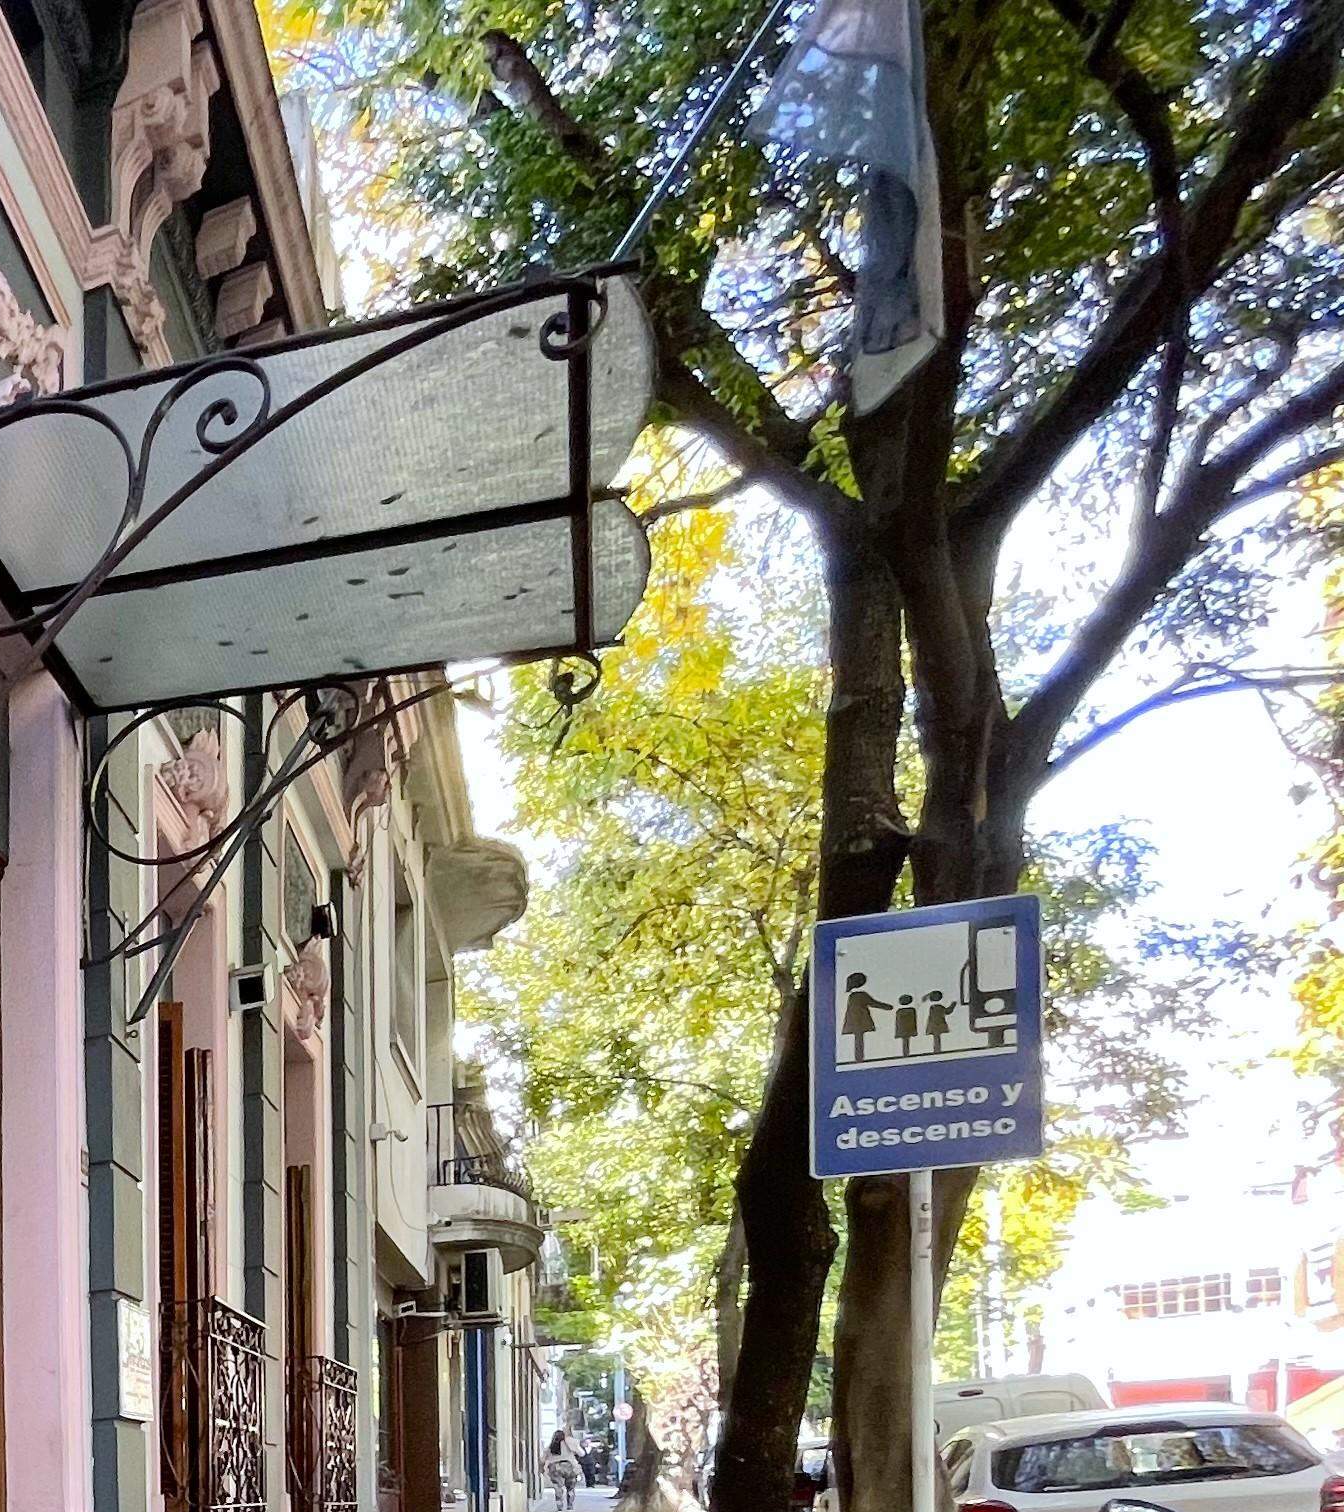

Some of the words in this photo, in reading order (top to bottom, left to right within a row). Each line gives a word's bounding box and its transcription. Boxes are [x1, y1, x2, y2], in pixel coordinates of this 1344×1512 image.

[828, 1086, 989, 1119] Ascenso
[1001, 1082, 1024, 1107] y
[836, 1117, 1017, 1150] descenso
